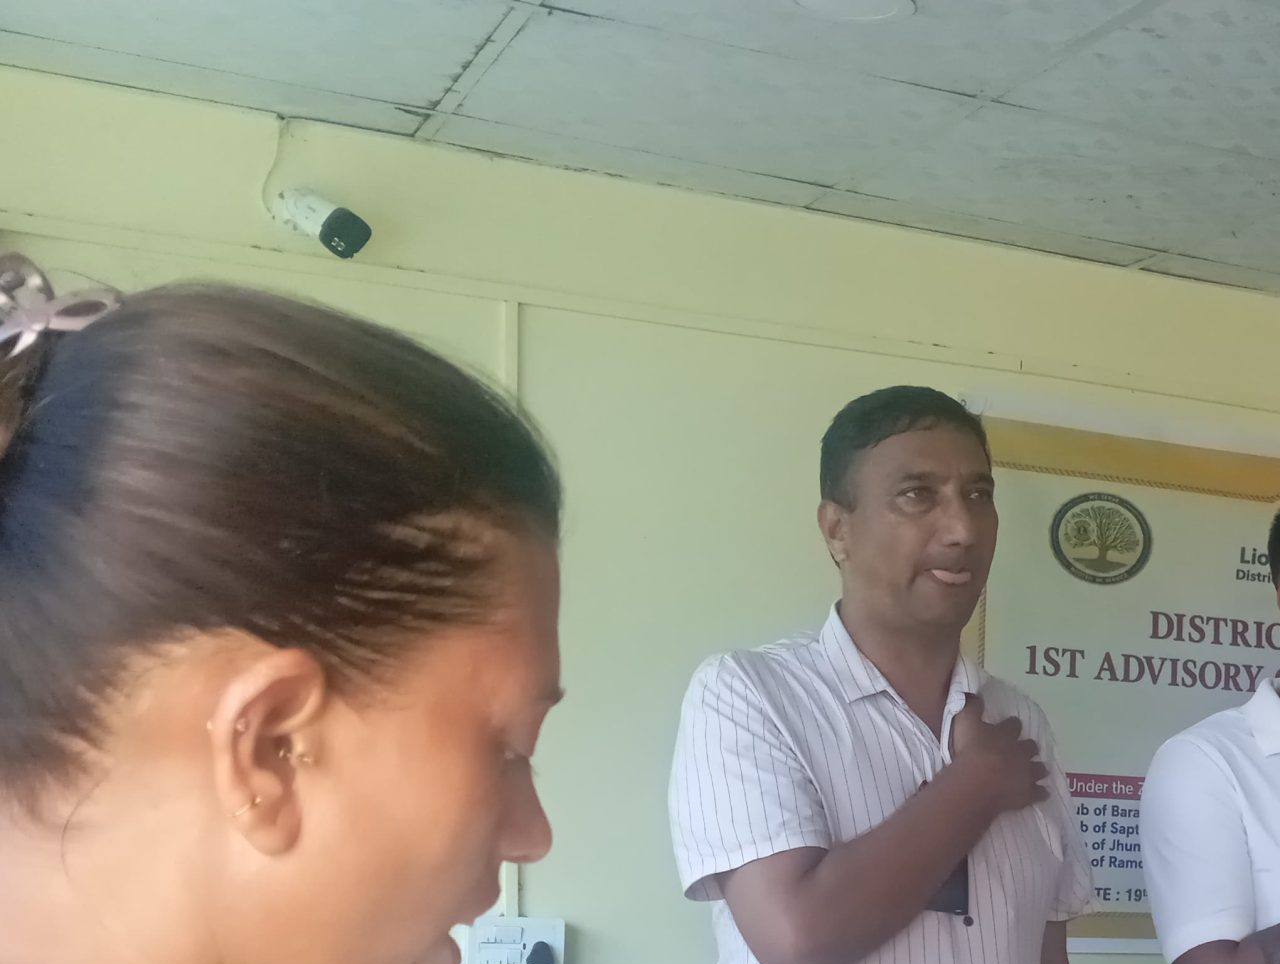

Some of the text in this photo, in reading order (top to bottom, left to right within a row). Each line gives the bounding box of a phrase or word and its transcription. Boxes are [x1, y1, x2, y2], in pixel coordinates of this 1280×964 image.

[1240, 547, 1269, 566] Lio
[1236, 569, 1270, 584] Distri
[1025, 645, 1085, 678] 1ST
[1094, 651, 1264, 692] ADVISORY
[1067, 778, 1108, 793] Under
[1112, 781, 1134, 794] the
[1093, 804, 1107, 816] of
[1111, 805, 1140, 818] Bara
[1093, 821, 1107, 834] of
[1110, 822, 1139, 838] Sapt
[1092, 838, 1106, 850] of
[1091, 855, 1105, 867] of
